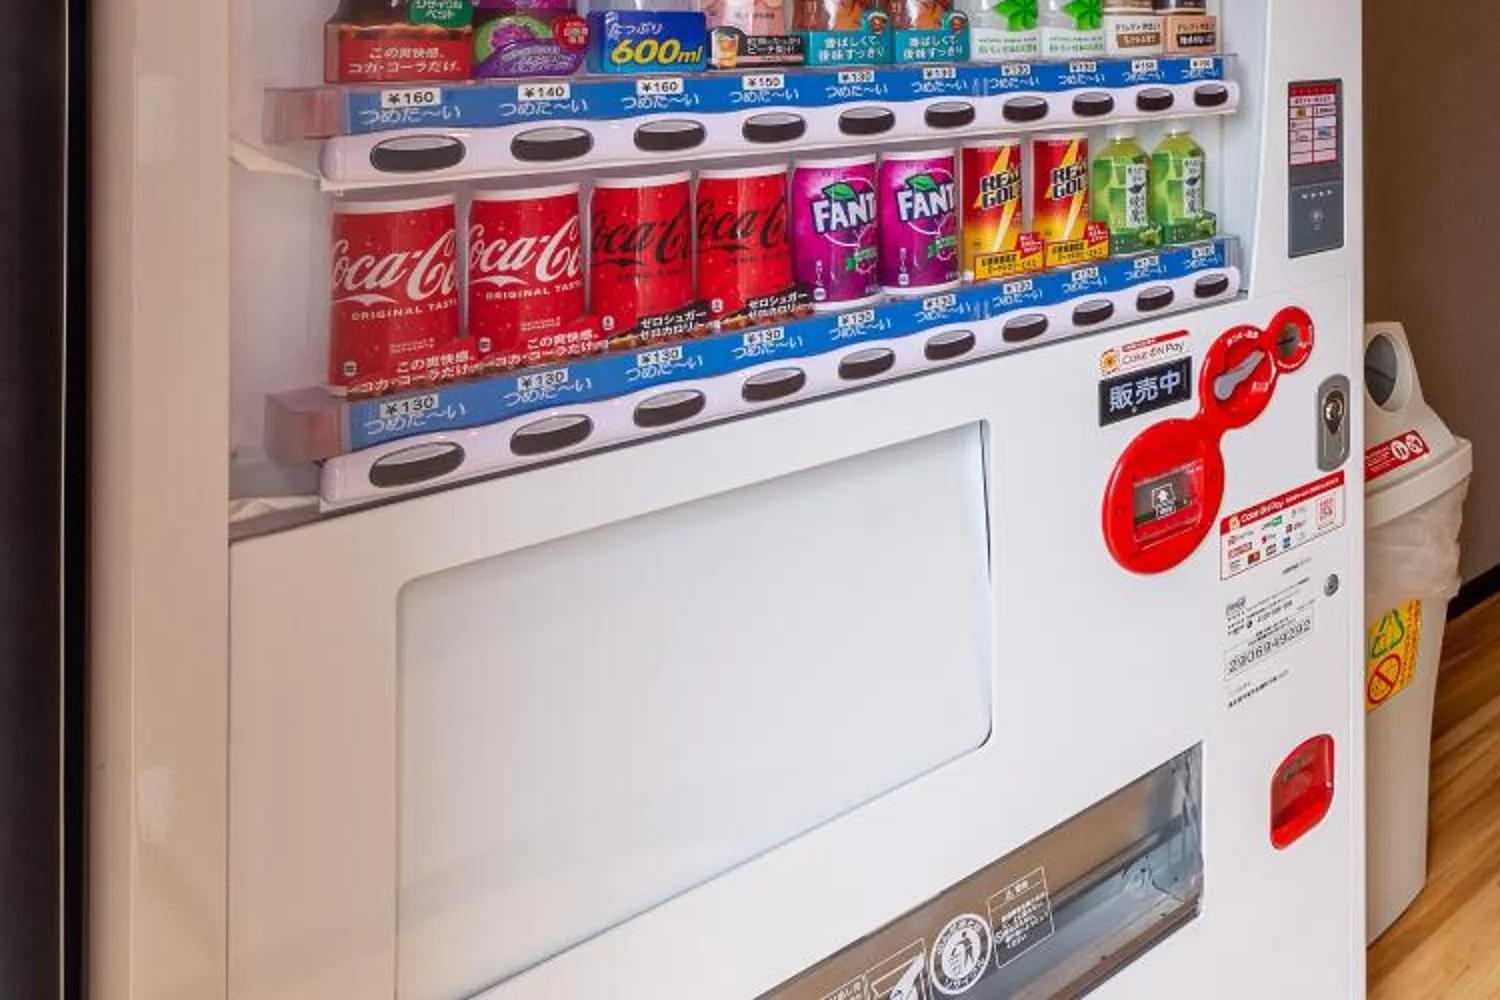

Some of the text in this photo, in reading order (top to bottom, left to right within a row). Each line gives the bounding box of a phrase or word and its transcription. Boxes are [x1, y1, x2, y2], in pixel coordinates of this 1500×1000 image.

[607, 21, 663, 39] たっぷり
[610, 39, 705, 65] 600ml
[523, 85, 566, 99] ¥140
[641, 81, 678, 93] ¥160
[388, 91, 435, 105] ¥160
[485, 287, 550, 301] ORIGINAL
[748, 291, 808, 309] ゼロシュガー
[352, 307, 423, 321] ORIGINAL
[640, 309, 707, 328] ゼロシュガー
[641, 349, 680, 365] ¥130
[522, 370, 565, 387] ¥130
[1109, 367, 1182, 412] 販売中
[386, 396, 434, 415] ¥130
